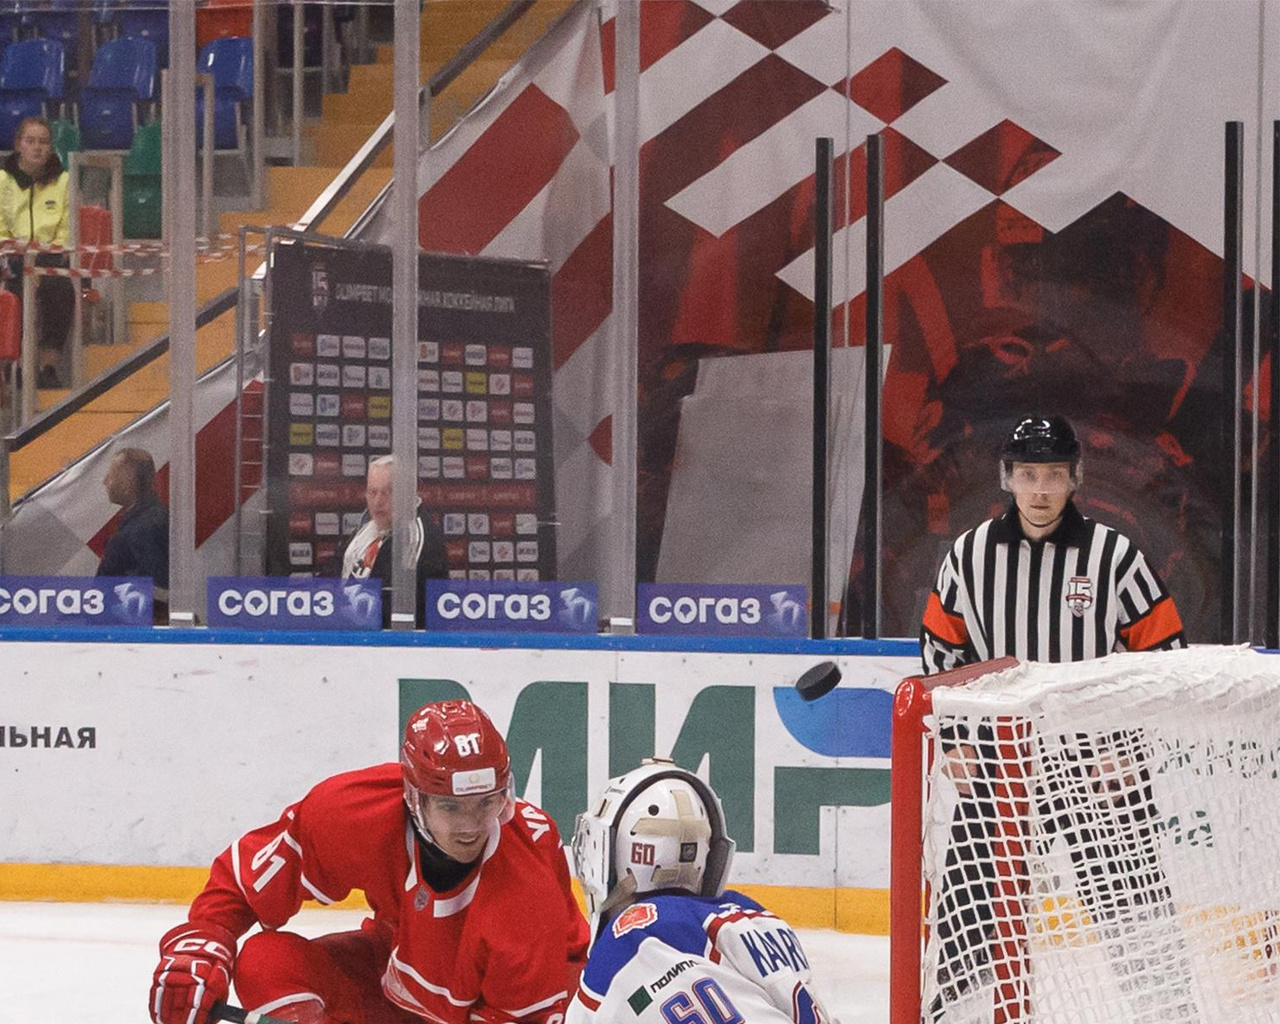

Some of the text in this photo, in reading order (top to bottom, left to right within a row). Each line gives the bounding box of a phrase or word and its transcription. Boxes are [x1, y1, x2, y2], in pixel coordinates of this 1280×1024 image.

[454, 732, 481, 757] 81
[631, 841, 656, 867] 60
[173, 938, 233, 966] CC
[650, 959, 700, 994] ПОЛИПЛ
